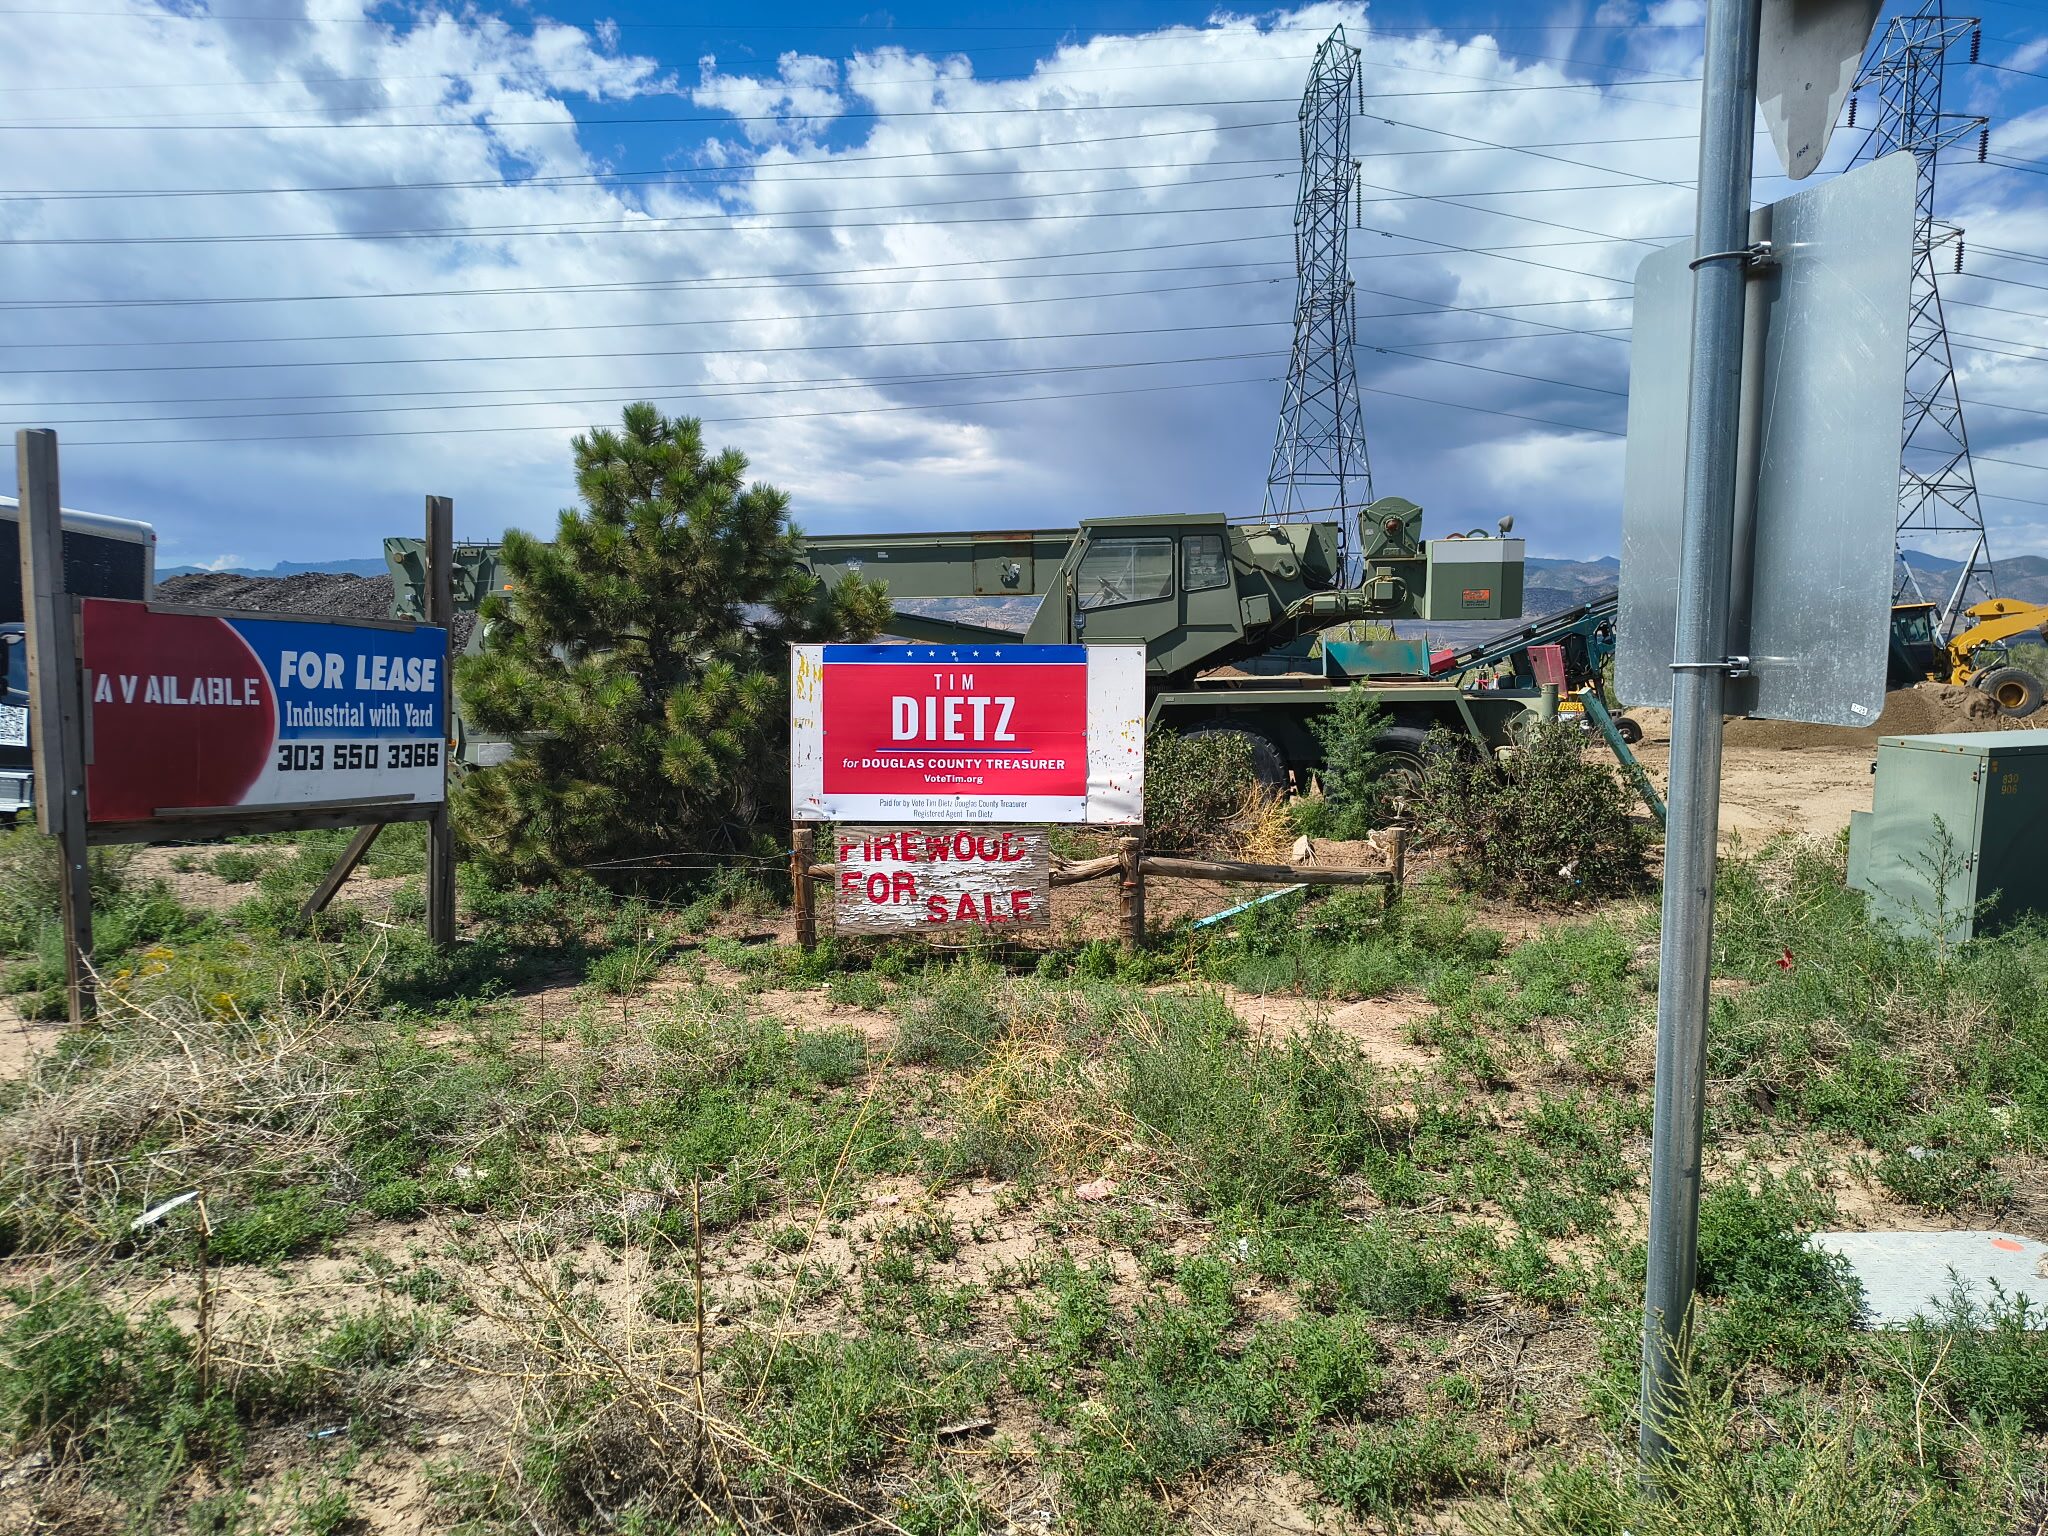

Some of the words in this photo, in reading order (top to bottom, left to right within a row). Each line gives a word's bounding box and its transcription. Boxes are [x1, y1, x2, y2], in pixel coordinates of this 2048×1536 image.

[280, 651, 344, 690] FOR
[355, 654, 437, 692] LEASE
[933, 673, 974, 690] TIM
[94, 672, 260, 706] AVAILABLE
[286, 701, 364, 727] Industrial
[368, 701, 400, 727] with
[404, 703, 434, 727] Yard
[892, 696, 1016, 742] DIETZ
[277, 744, 324, 771] 303
[333, 744, 379, 770] 550
[387, 743, 439, 769] 3366
[842, 758, 859, 769] for
[861, 758, 925, 770] DOUGLAS
[928, 758, 982, 770] COUNTY
[985, 759, 1065, 770] TREASURER
[924, 773, 984, 785] VoteTim.org
[879, 798, 893, 807] Paid
[893, 799, 902, 807] for
[902, 799, 910, 808] by
[911, 799, 925, 807] Vote
[926, 799, 937, 807] Tim
[938, 799, 953, 807] Dietz
[954, 799, 978, 809] Douglas
[978, 800, 999, 809] County
[1000, 800, 1028, 808] Treasurer
[913, 809, 945, 819] Registered
[945, 810, 963, 819] Agent
[966, 810, 977, 818] Tim
[978, 810, 993, 818] Dietz
[839, 829, 1026, 863] FIREWOOD
[840, 870, 918, 904] FOR
[926, 889, 1034, 925] SALE
